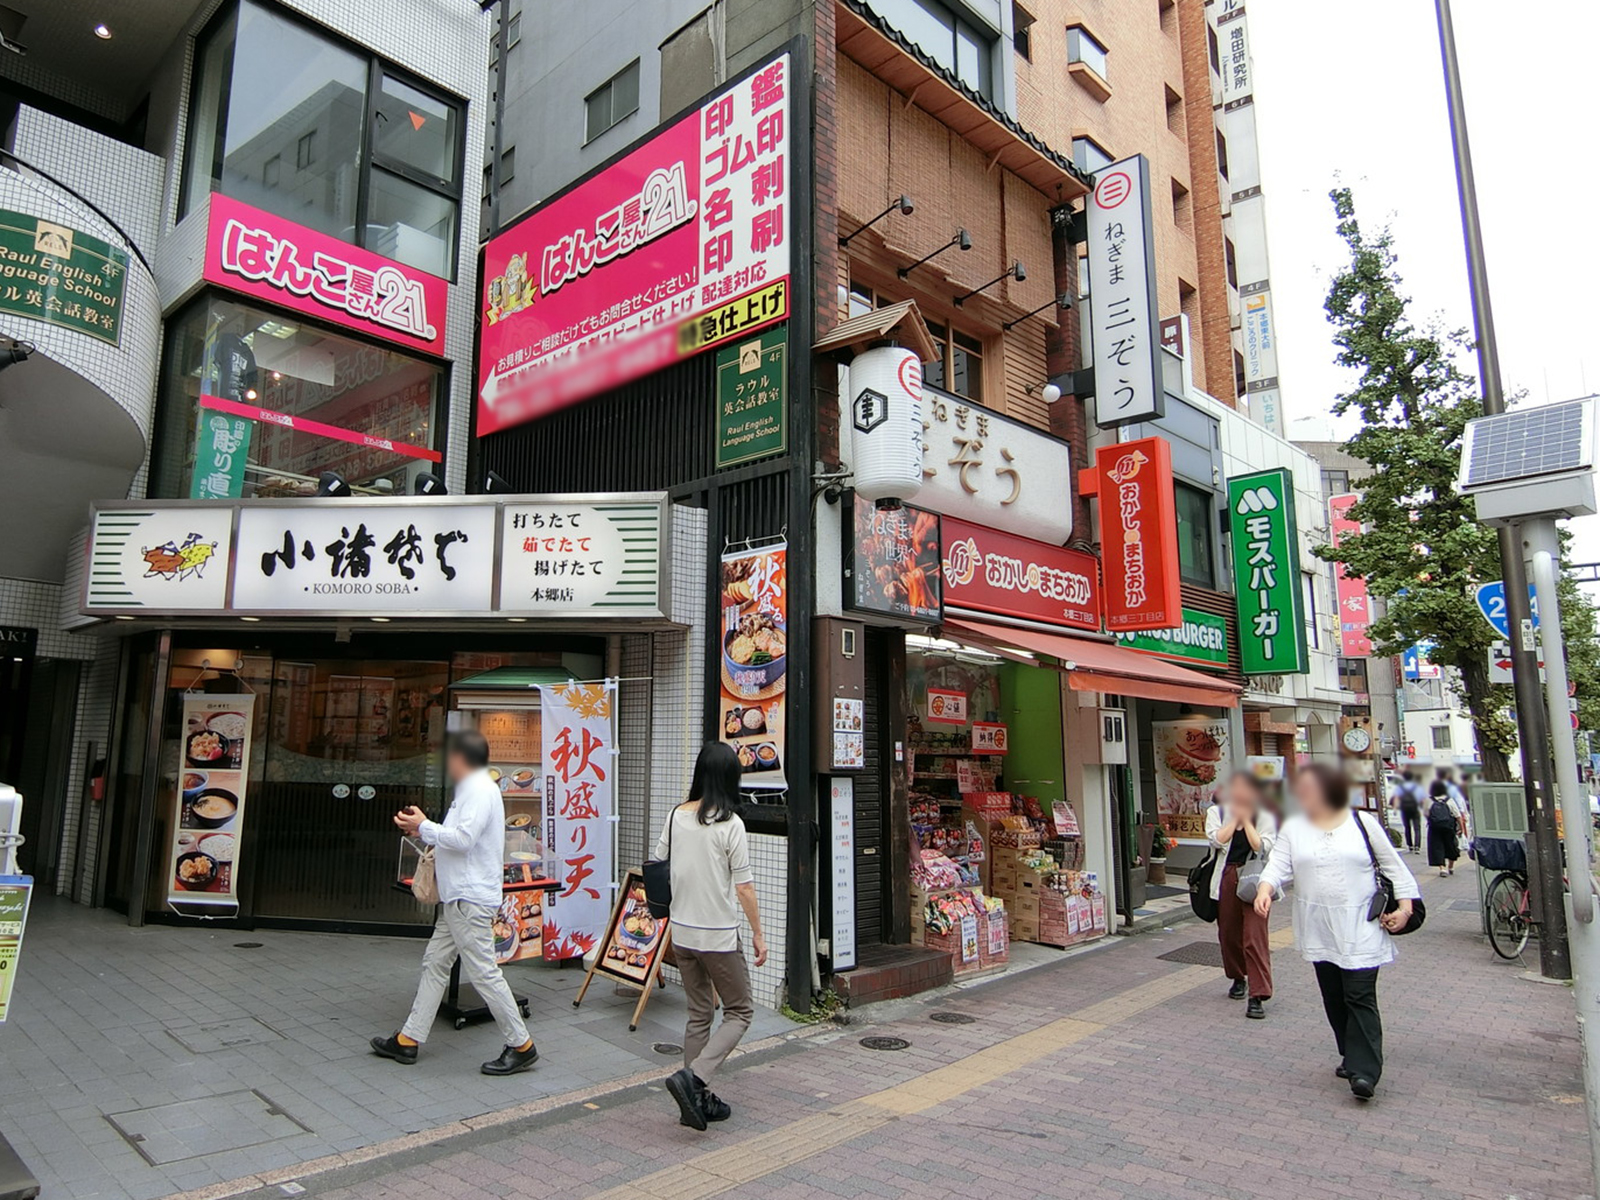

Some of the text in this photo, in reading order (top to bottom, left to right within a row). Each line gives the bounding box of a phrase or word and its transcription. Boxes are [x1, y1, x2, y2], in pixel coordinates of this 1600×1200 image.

[1230, 26, 1247, 90] 増田研究所
[1231, 98, 1245, 108] 6F
[704, 107, 784, 188] ゴム印
[703, 155, 784, 232] 名刺
[1239, 189, 1255, 199] 5F
[703, 203, 784, 275] 印刷
[0, 246, 102, 287] Raul English
[101, 263, 120, 278] 4F
[0, 264, 117, 308] guage School
[701, 259, 767, 304] 配達対応
[1248, 283, 1262, 291] 4F
[0, 286, 115, 332] ル英会話教室
[681, 283, 784, 349] 急仕上げ
[1105, 222, 1136, 410] ねぎま 三ぞう
[769, 352, 781, 363] 4F
[735, 375, 770, 397] ラウル
[1256, 380, 1270, 388] 3F
[724, 387, 780, 417] 英会話教室
[727, 415, 774, 436] Raul English
[931, 396, 989, 438] ねぎま
[722, 424, 780, 447] Language School
[513, 513, 581, 529] 打ちたて
[523, 537, 592, 553] 茹でたて
[534, 560, 604, 577] 揚げたて
[985, 553, 1092, 606] おかしのまちおか
[313, 583, 411, 595] KOMORO SOBA
[531, 587, 574, 602] 本郷店
[1247, 516, 1279, 661] モスバーガー
[1063, 608, 1094, 623] 本郷三丁目店
[1110, 611, 1165, 625] 本郷三丁目店
[1173, 621, 1223, 650] BURGER
[1186, 725, 1226, 742] あっぱれ
[550, 726, 606, 900] 秋盛り天
